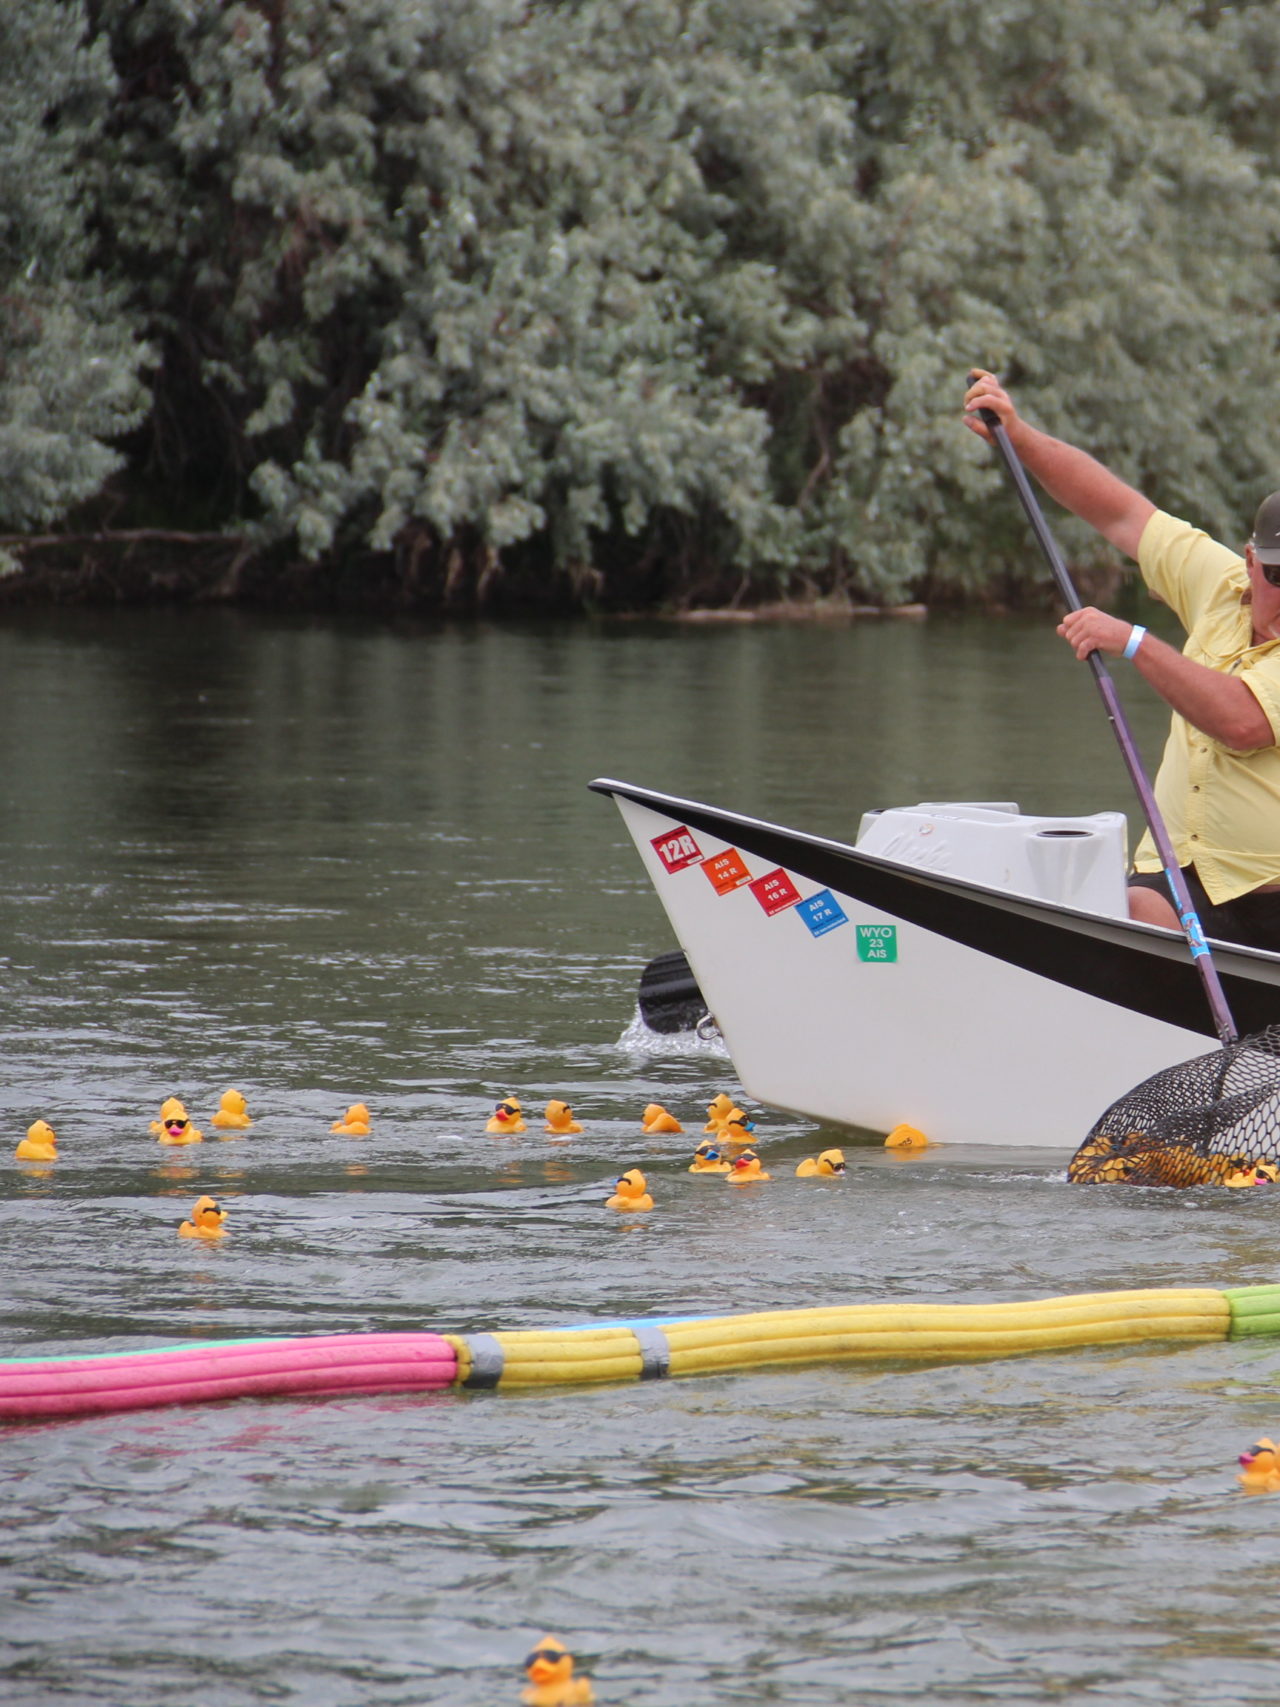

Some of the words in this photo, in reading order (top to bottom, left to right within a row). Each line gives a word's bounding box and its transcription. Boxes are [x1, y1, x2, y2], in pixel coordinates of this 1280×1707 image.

[660, 835, 697, 863] 12R
[714, 858, 730, 870] AIS
[717, 871, 729, 879] 14
[729, 867, 738, 875] R
[764, 879, 779, 891] AIS
[768, 892, 779, 901] 16
[779, 888, 788, 896] R
[809, 899, 824, 912] AIS
[812, 911, 823, 922] 17
[860, 927, 892, 938] WYO
[869, 938, 884, 948] 23
[867, 949, 887, 959] AIS
